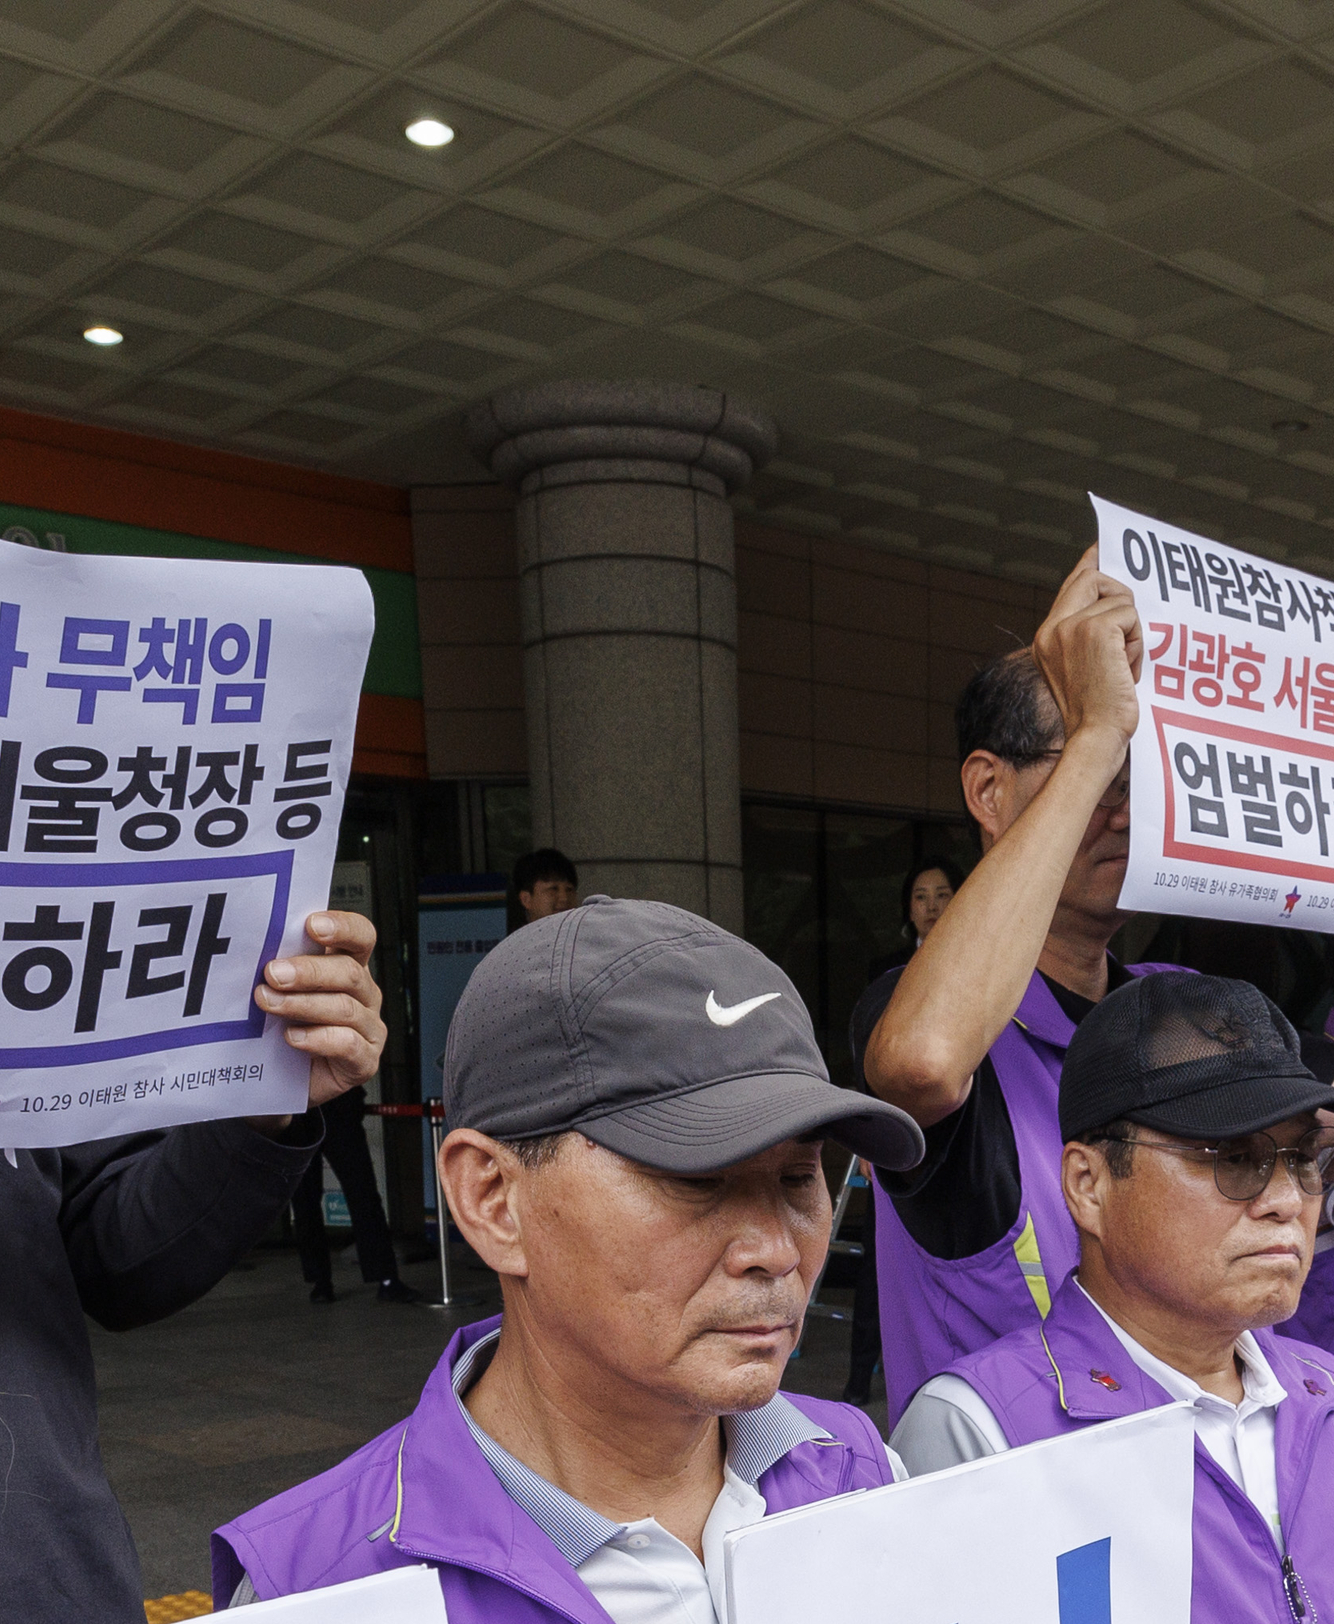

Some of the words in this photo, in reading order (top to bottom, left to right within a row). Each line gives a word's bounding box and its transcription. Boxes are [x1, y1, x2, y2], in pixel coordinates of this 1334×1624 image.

[46, 616, 273, 727] 무책임
[1149, 621, 1267, 714] 김광호
[273, 738, 335, 842] 등
[1153, 871, 1180, 888] 10.29
[1181, 875, 1208, 894] 이태원
[1209, 877, 1227, 895] 참사
[1228, 880, 1280, 903] 유가족협의회
[1307, 894, 1330, 910] 10.29
[19, 1094, 72, 1114] 10.29
[78, 1082, 129, 1110] 이태원
[132, 1077, 166, 1100] 참사
[170, 1062, 265, 1093] 시민대책회의
